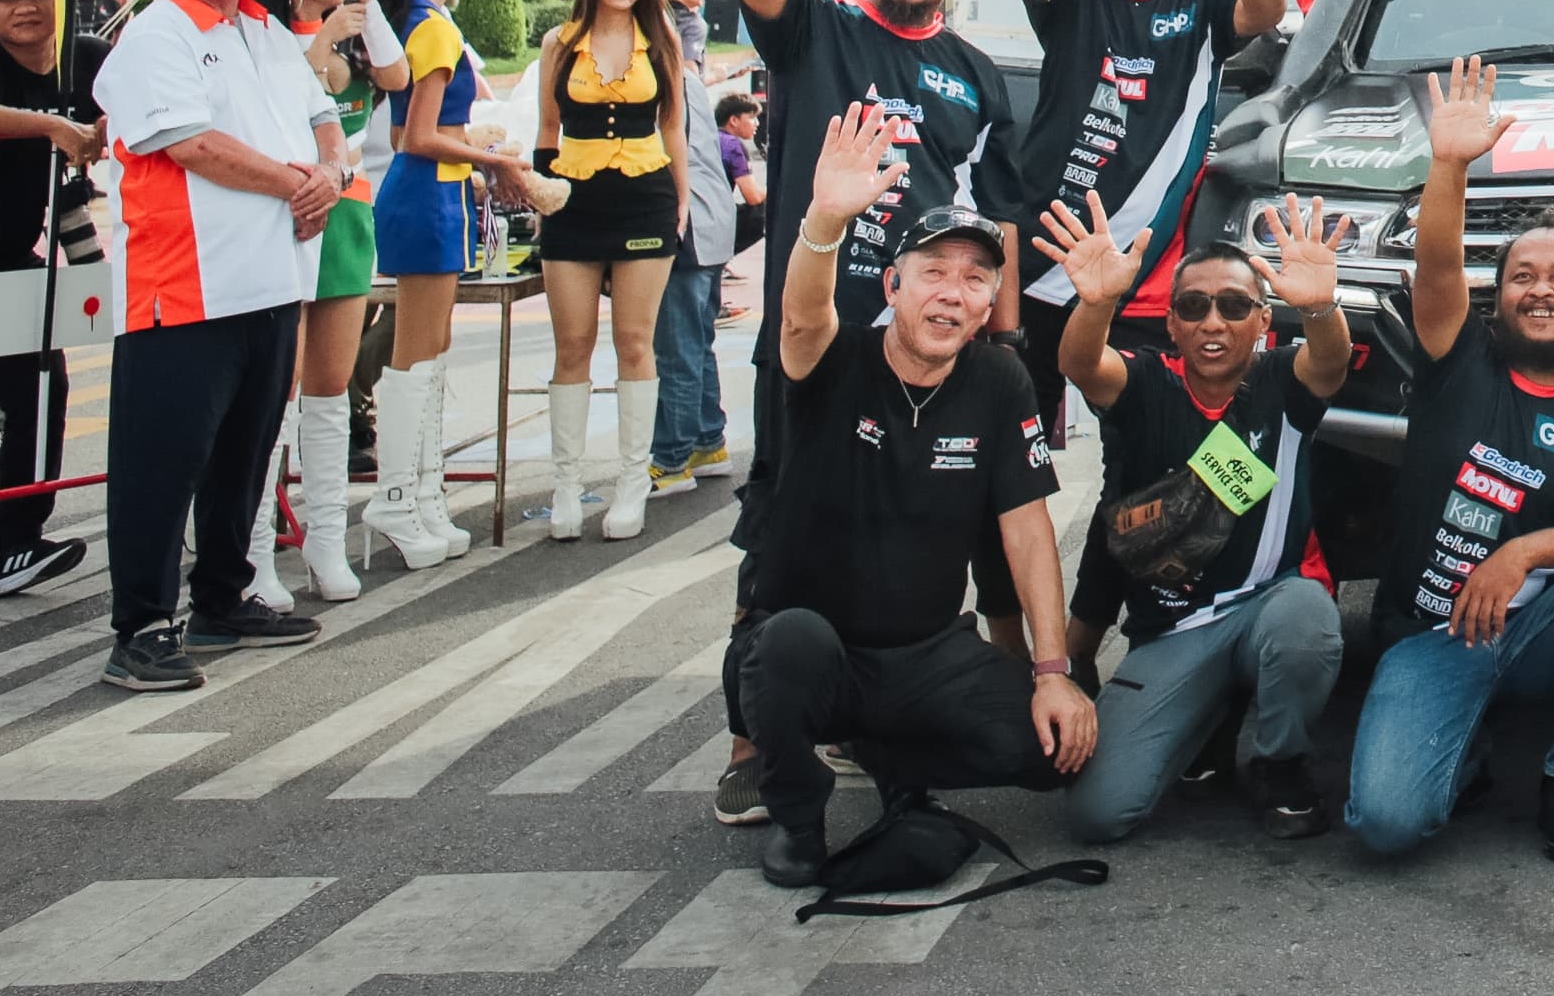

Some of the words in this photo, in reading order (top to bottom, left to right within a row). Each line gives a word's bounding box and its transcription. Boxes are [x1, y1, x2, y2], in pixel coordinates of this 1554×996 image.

[1152, 12, 1189, 37] GHP
[1113, 55, 1155, 70] oodrich
[1083, 113, 1127, 139] Belkote
[1070, 147, 1109, 168] PRO7
[1065, 166, 1098, 186] BRAID
[1200, 452, 1234, 487] SERVICE
[1229, 484, 1254, 505] CREW
[1226, 458, 1253, 485] AXCR
[1461, 467, 1518, 508] MOTUL
[1448, 497, 1497, 533] Kahf
[1435, 527, 1488, 560] Belkote
[1422, 569, 1462, 594] PRO7
[1416, 591, 1452, 613] BRAID
